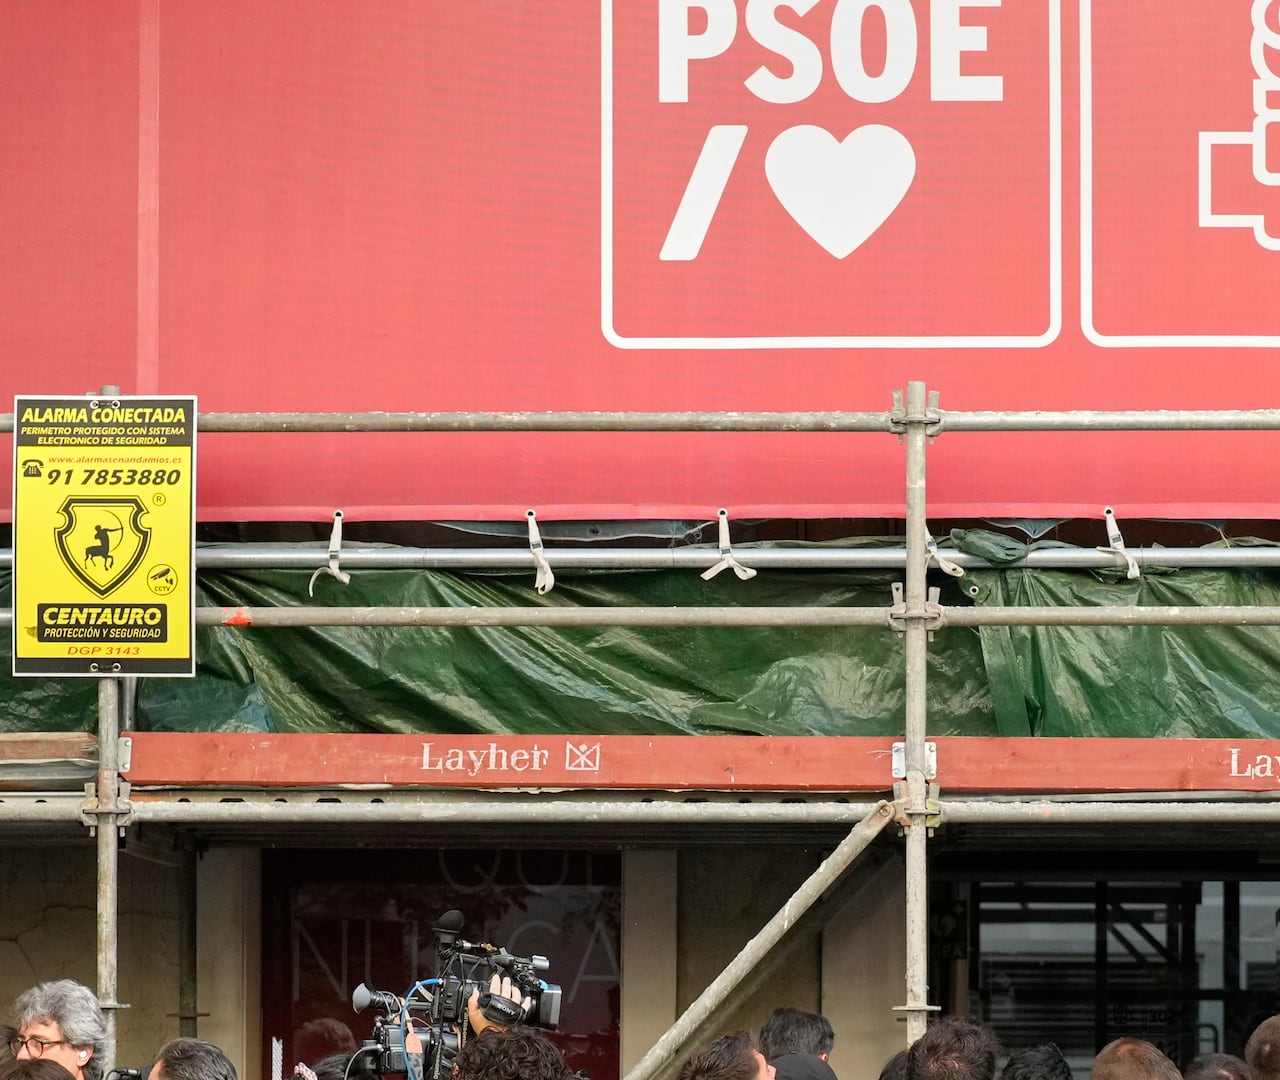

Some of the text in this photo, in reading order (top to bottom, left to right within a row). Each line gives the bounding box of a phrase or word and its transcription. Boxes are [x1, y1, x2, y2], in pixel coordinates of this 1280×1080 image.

[658, 0, 1004, 104] PSOE
[21, 407, 186, 423] ALARMA CONECTADA
[21, 426, 186, 435] PERIMETRO PROTEGIDO CON SISTEMA
[37, 436, 168, 445] ELECTRONICO DE SEGURIDAD
[47, 469, 181, 485] 91 7853880
[42, 607, 162, 625] CENTAURO
[43, 626, 161, 638] PROTECCIÓN Y SEGURIDAD
[67, 646, 140, 655] DGP 3143
[420, 742, 549, 776] Layher
[496, 1002, 516, 1016] SONY
